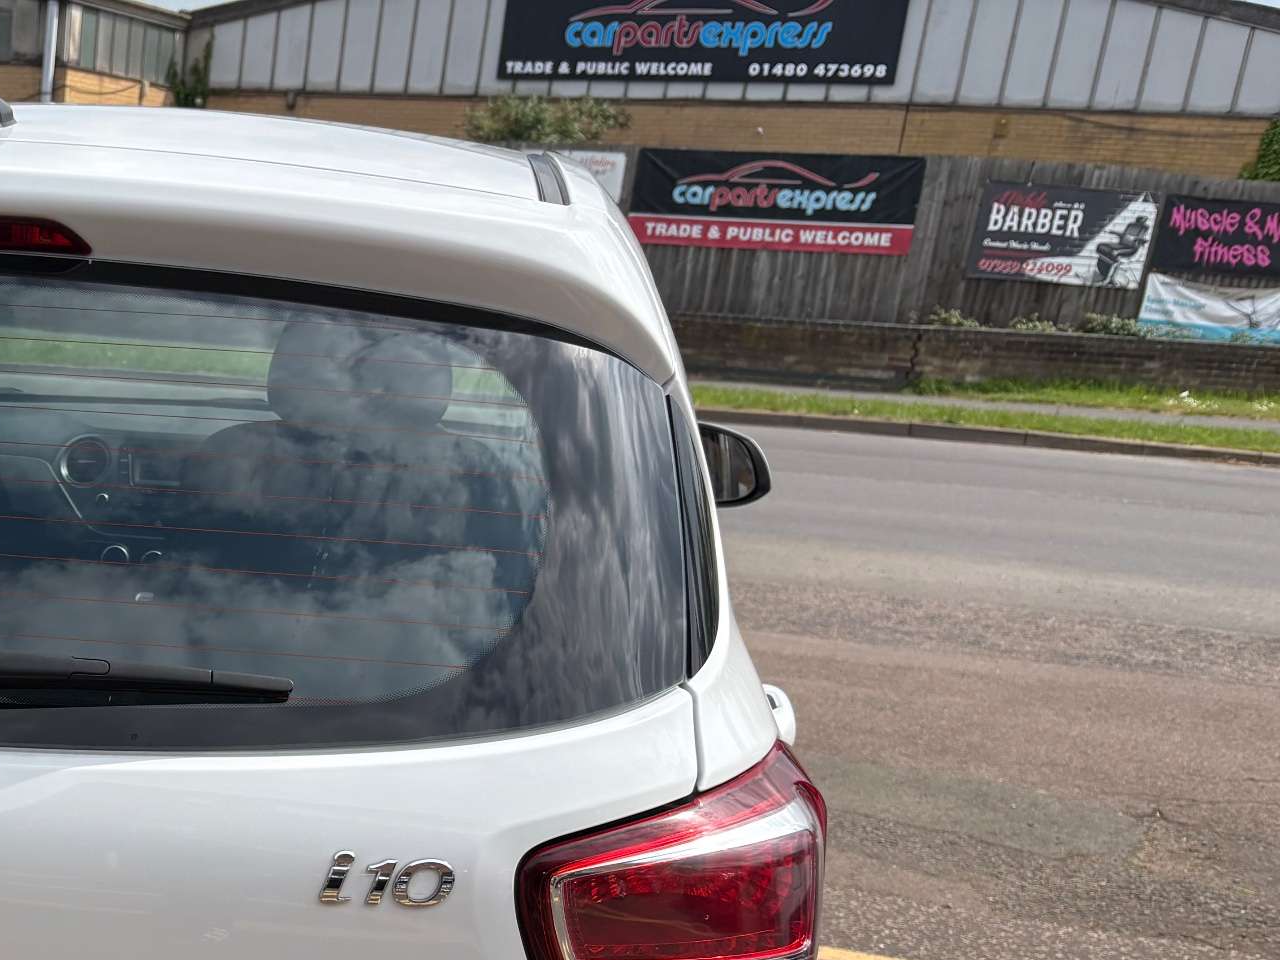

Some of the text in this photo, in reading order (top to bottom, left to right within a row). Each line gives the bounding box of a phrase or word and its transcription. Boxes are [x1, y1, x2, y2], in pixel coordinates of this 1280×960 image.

[565, 15, 832, 56] carpartsexpress
[506, 61, 888, 78] TRADE & PUBLIC WELCOME 01480 473698
[672, 183, 877, 215] carpartsexpress
[645, 222, 893, 247] TRADE & PUBLIC WELCOME
[987, 202, 1084, 238] BARBER
[1170, 204, 1241, 235] Muscle
[1244, 207, 1264, 240] &
